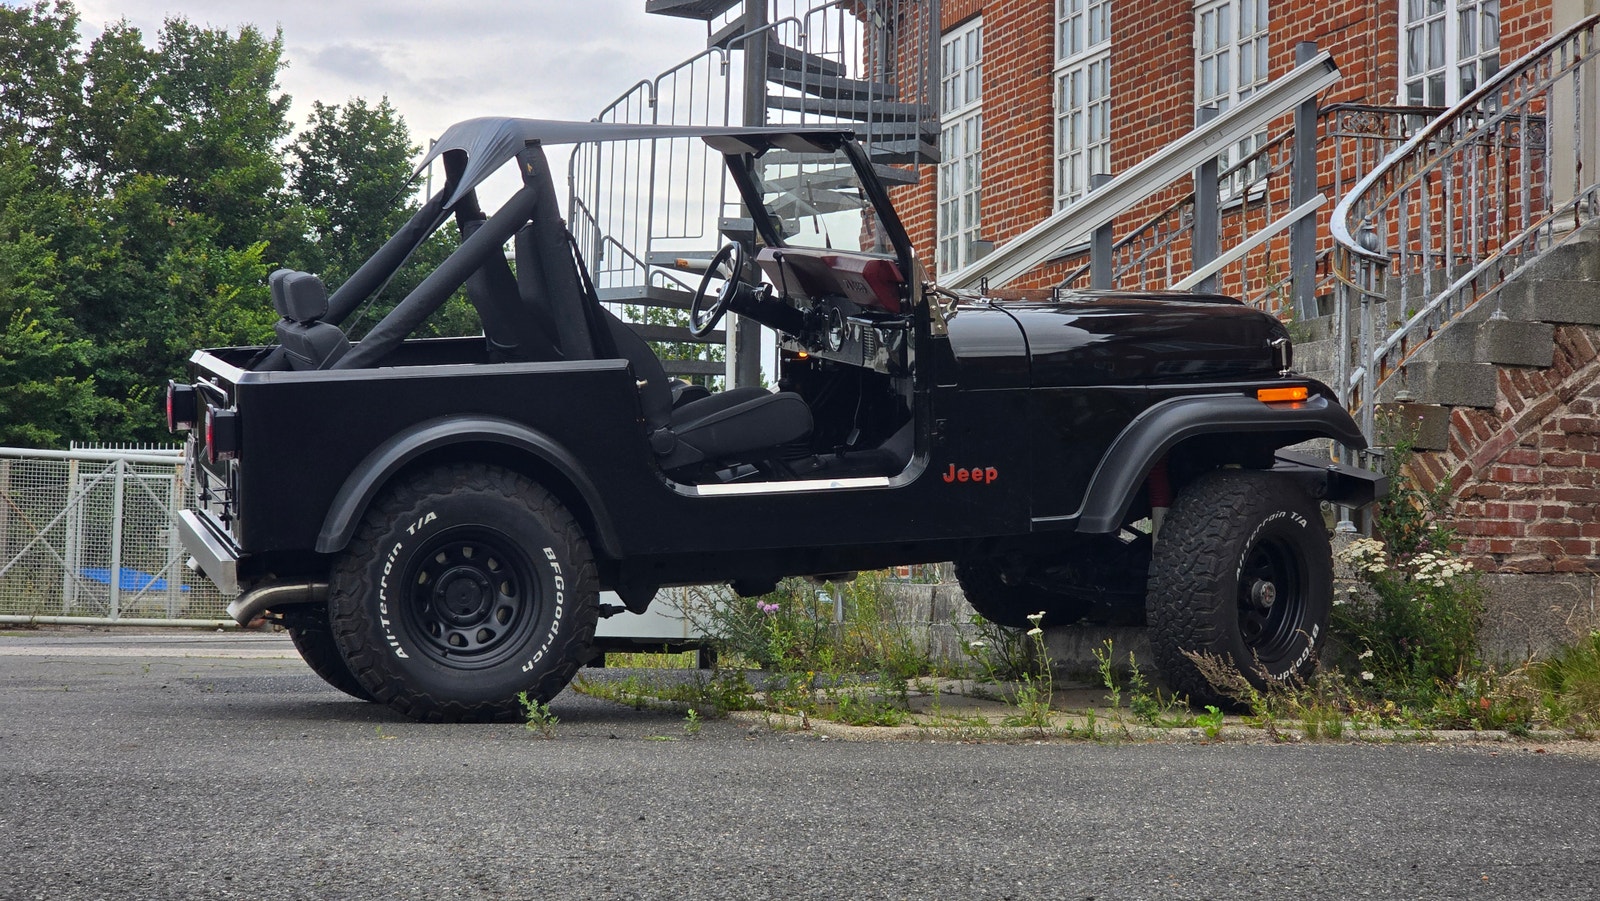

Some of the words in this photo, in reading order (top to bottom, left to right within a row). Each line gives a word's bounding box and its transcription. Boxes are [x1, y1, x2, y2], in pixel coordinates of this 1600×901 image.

[942, 463, 998, 485] Jeep
[1290, 511, 1309, 528] T/A
[378, 543, 410, 660] All-Terrain
[406, 511, 438, 536] T/A
[522, 546, 565, 673] BFGoodrich
